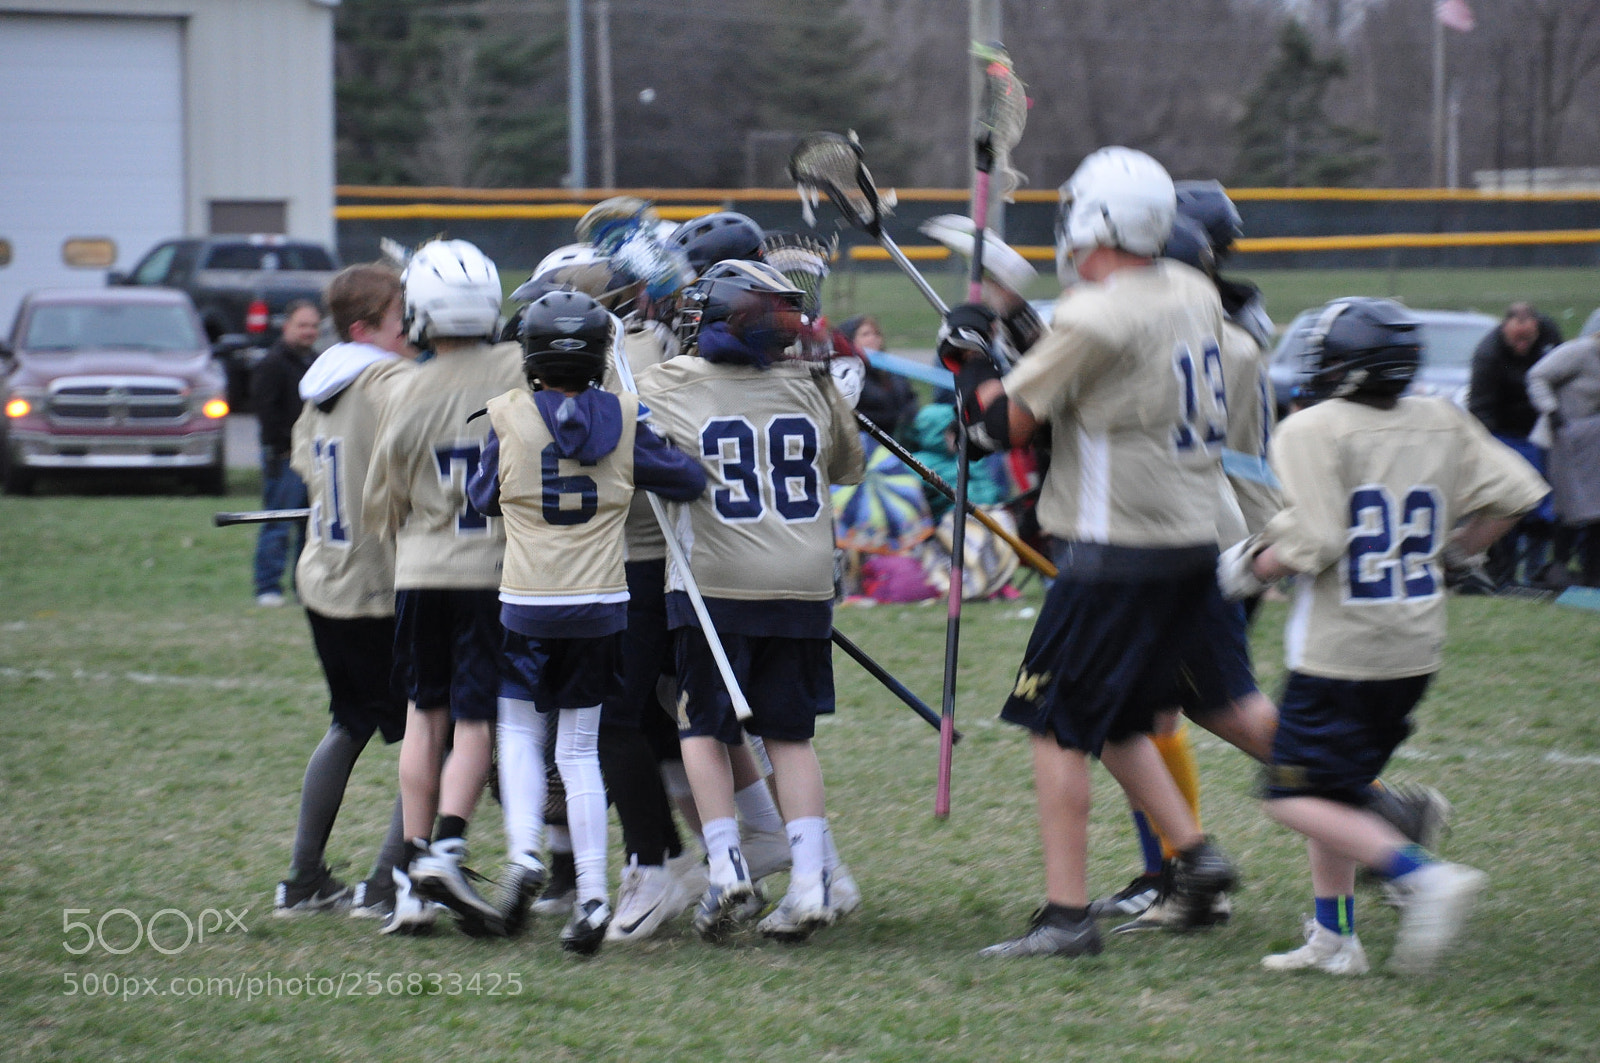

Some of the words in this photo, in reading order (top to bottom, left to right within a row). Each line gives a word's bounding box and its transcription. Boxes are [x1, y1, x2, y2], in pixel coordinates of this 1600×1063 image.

[1172, 340, 1229, 454] 13
[431, 437, 492, 537] 7
[541, 442, 598, 525] 6
[701, 413, 823, 524] 38
[1345, 484, 1447, 604] 22
